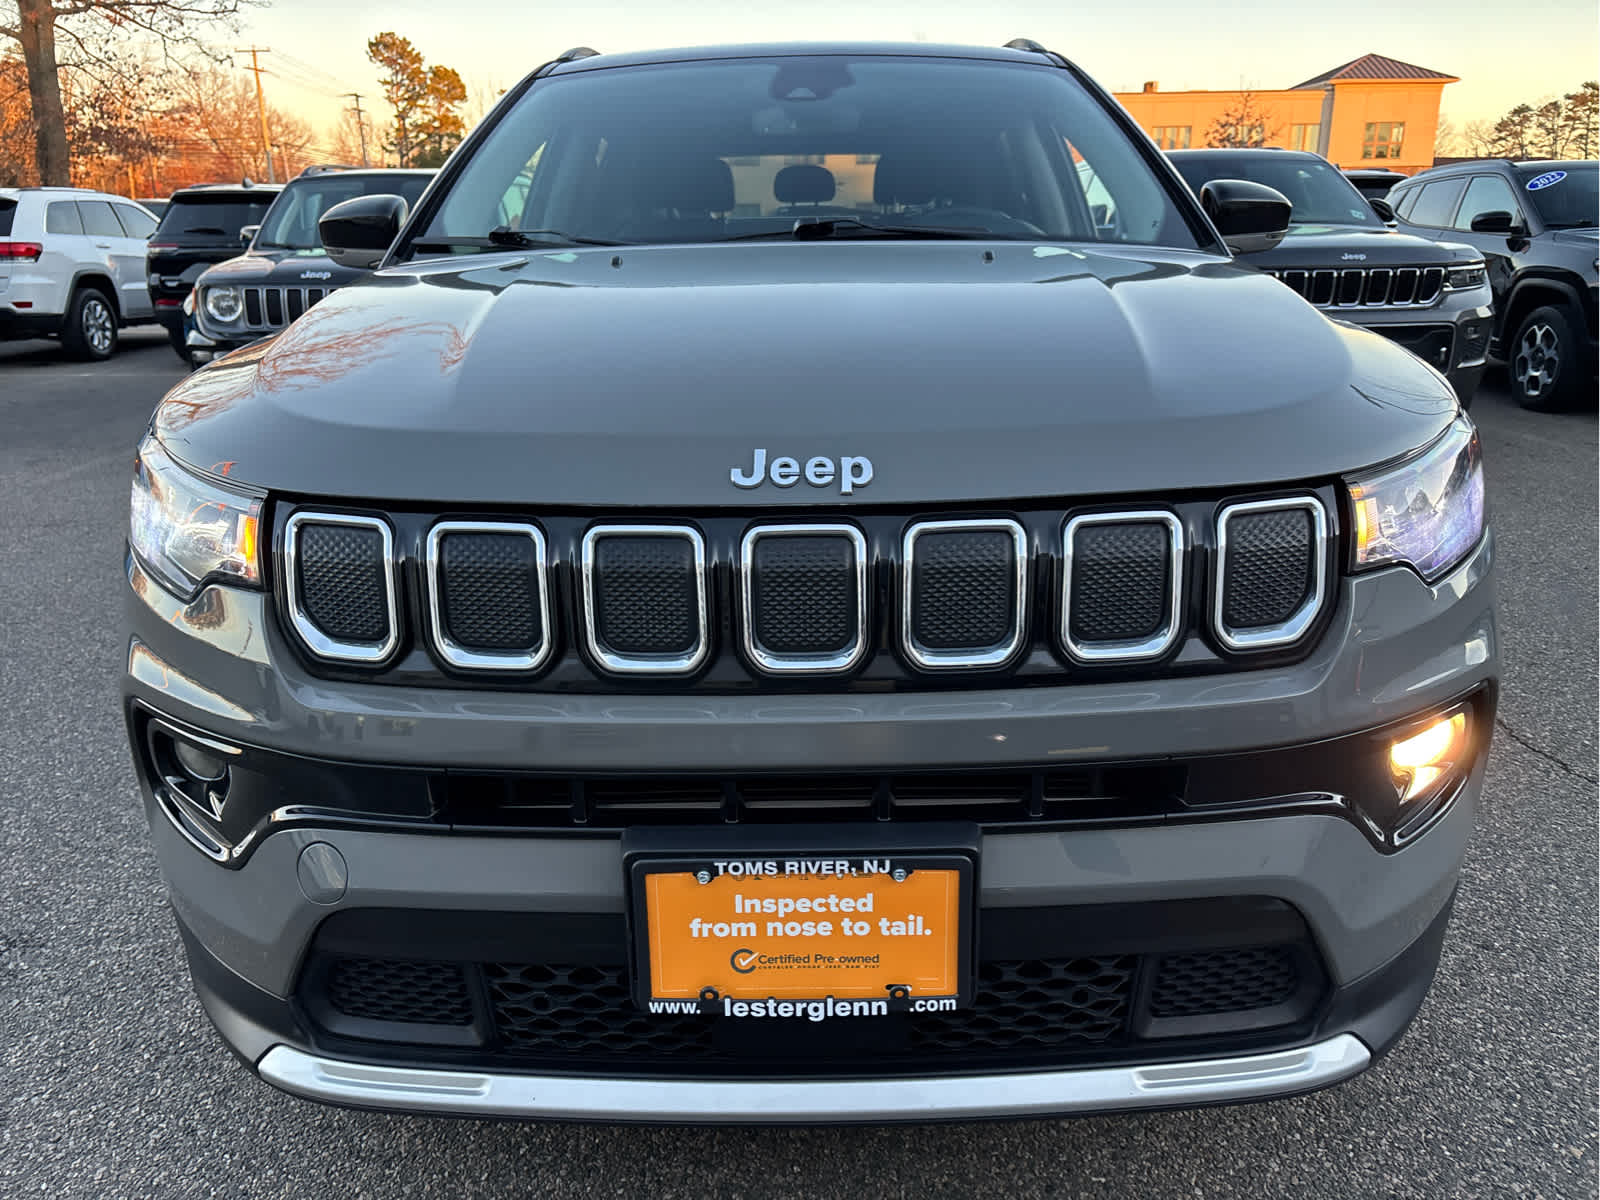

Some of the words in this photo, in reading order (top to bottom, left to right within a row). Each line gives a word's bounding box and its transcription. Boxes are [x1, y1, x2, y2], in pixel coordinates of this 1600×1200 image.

[1341, 252, 1367, 261] Jeep
[300, 270, 331, 280] Jeep
[730, 448, 874, 496] Jeep
[714, 861, 777, 876] TOMS
[785, 860, 857, 877] RIVER,
[864, 860, 890, 874] NJ
[735, 893, 873, 917] Inspected
[689, 918, 757, 937] from
[766, 920, 833, 936] nose
[841, 917, 871, 936] to
[878, 914, 932, 936] tail.
[758, 954, 810, 964] Certified
[814, 954, 880, 964] Pre-owned
[649, 1000, 701, 1014] www.
[724, 998, 888, 1022] lesterglenn
[909, 999, 957, 1012] .com
